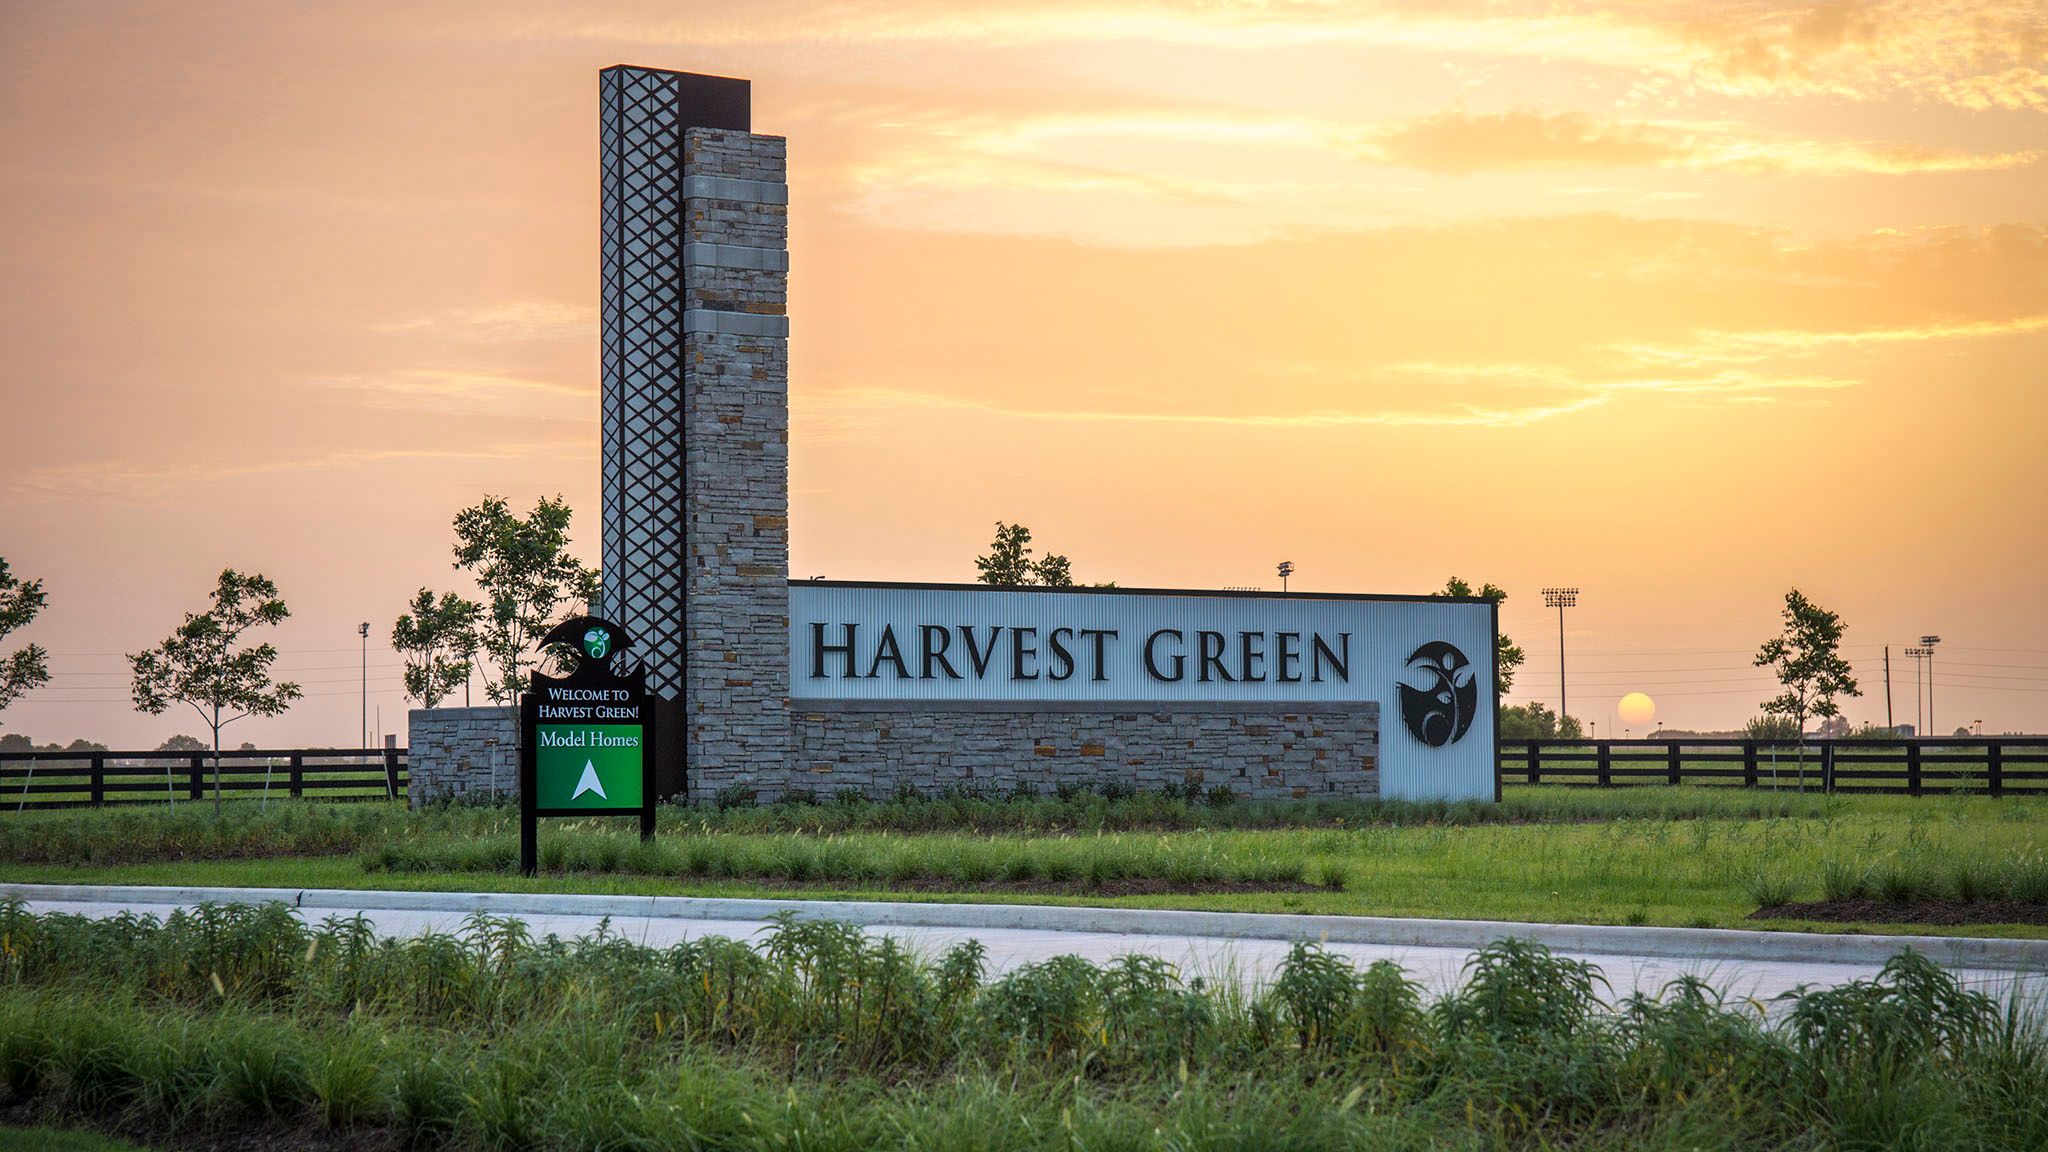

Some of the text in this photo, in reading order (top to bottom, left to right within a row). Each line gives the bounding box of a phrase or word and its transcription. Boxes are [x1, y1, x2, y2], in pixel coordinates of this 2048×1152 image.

[808, 622, 1352, 683] HARVEST GREEN
[548, 688, 629, 701] WELCOME TO
[538, 705, 639, 718] HARVEST GREEN!
[540, 731, 639, 747] Model Homes
